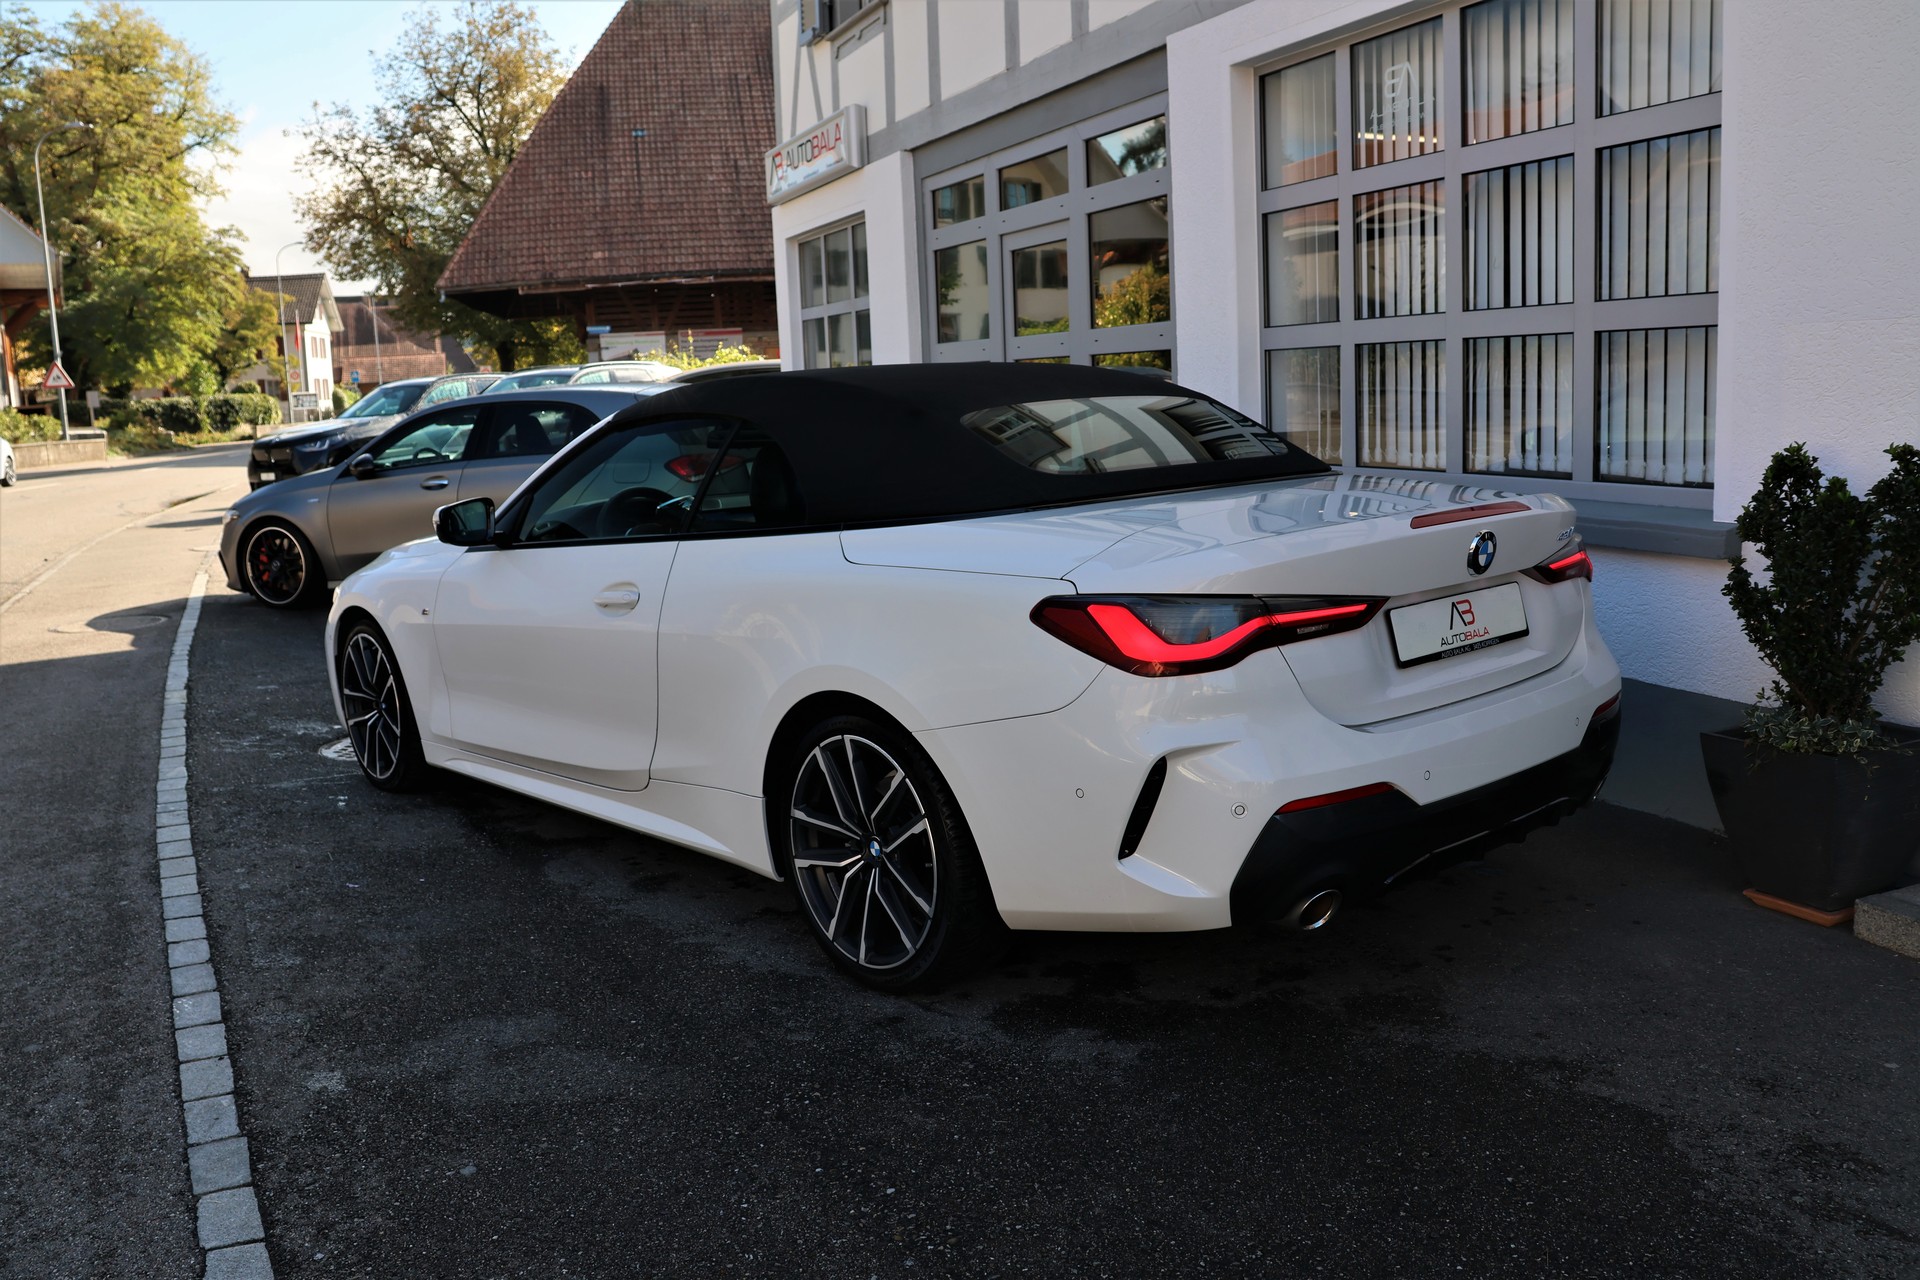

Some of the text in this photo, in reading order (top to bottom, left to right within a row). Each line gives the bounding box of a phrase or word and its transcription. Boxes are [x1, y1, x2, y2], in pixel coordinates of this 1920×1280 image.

[786, 123, 841, 169] AUTOBALA
[1450, 599, 1475, 630] AB
[1440, 627, 1490, 647] AUTOBALA
[1441, 650, 1453, 658] AUTO
